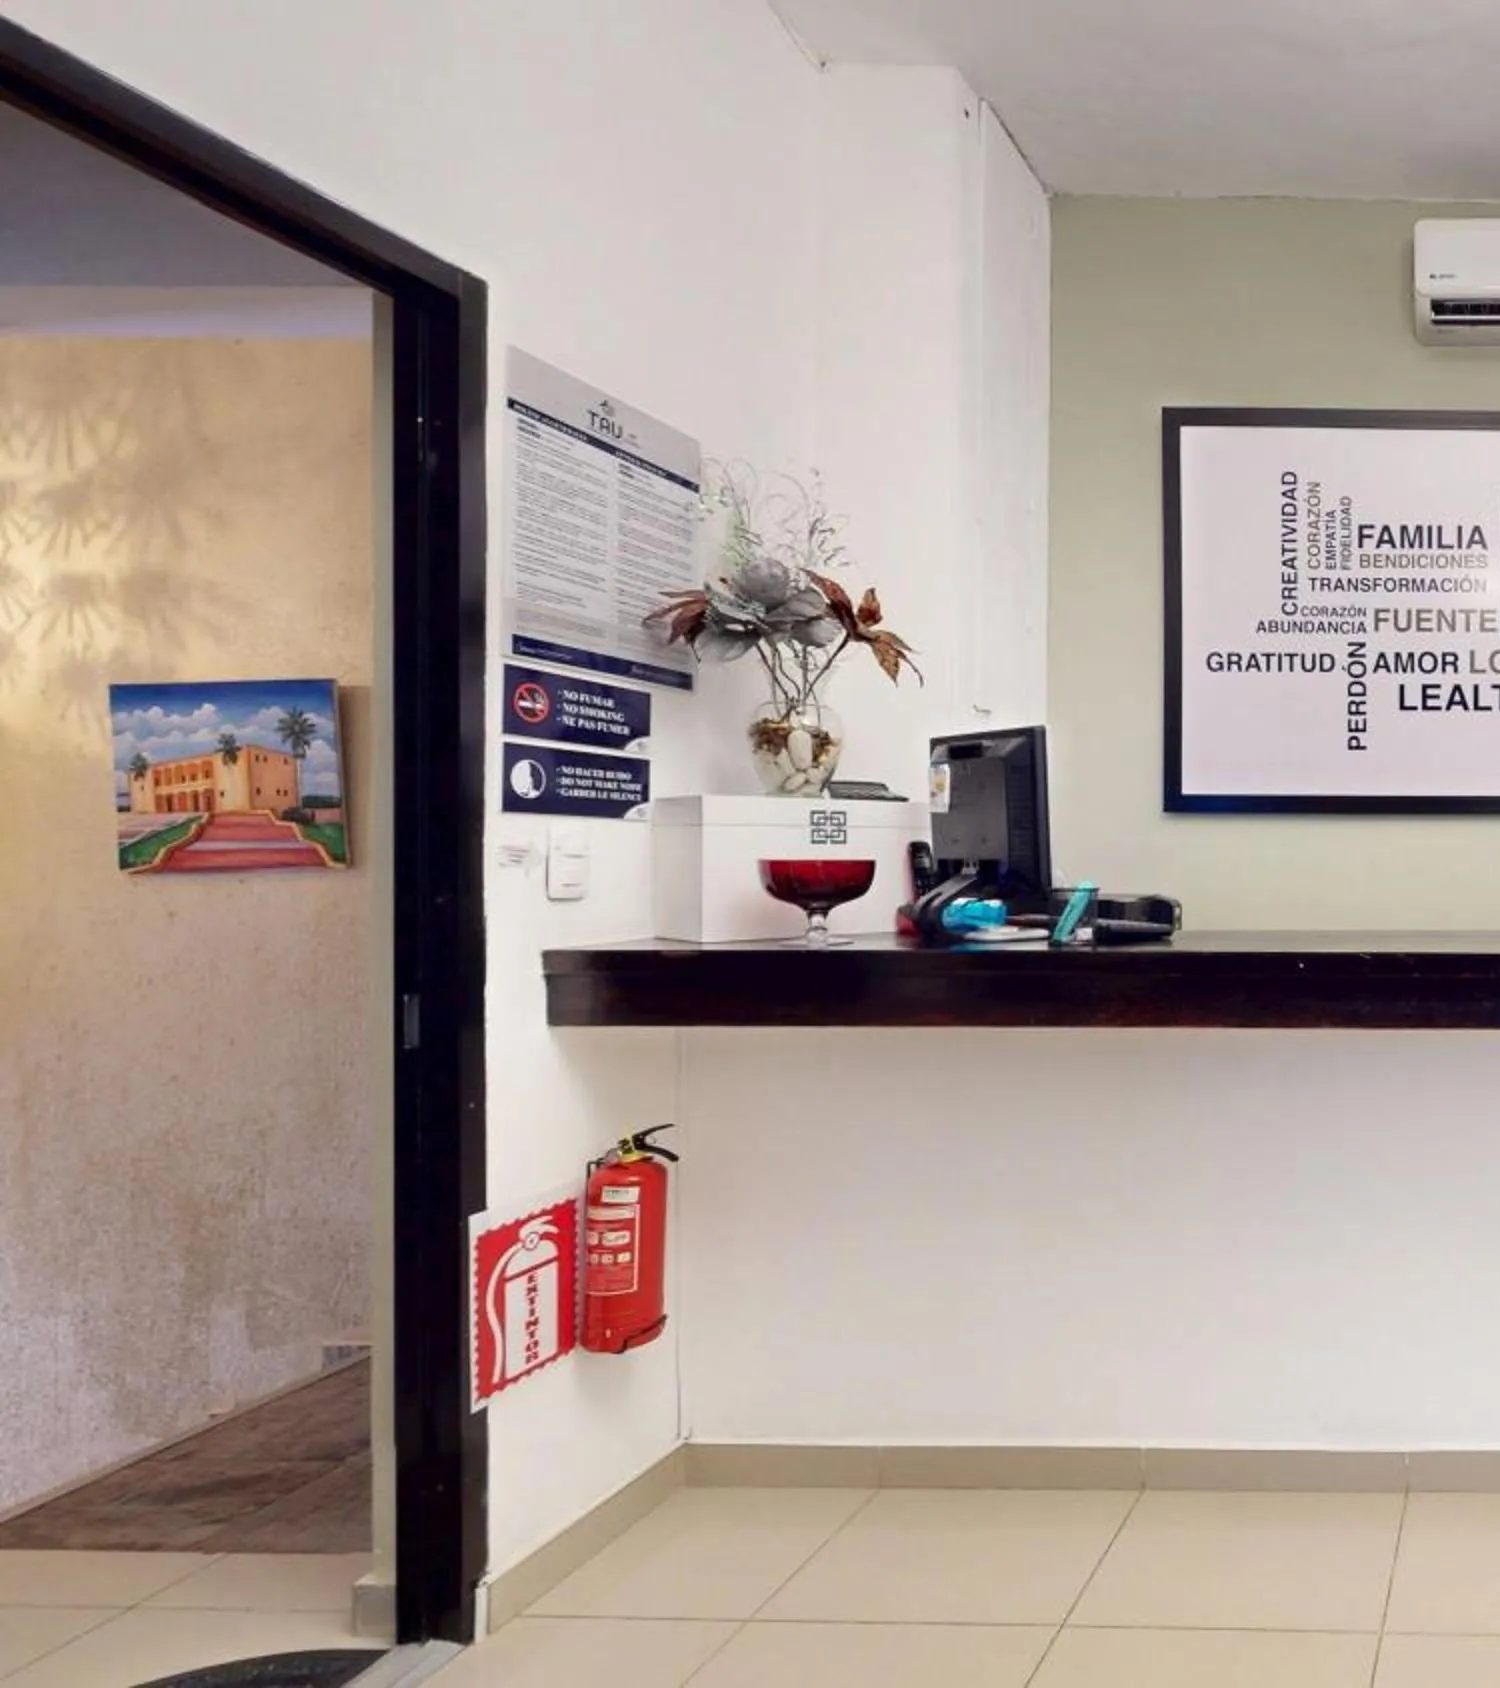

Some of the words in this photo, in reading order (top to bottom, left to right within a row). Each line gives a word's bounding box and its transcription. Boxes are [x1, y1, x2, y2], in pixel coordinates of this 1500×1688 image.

[588, 410, 623, 439] TAU
[1303, 481, 1321, 570] CORAZÓN
[1340, 496, 1353, 570] FIDELIDAD
[1357, 524, 1488, 550] FAMILIA
[1281, 471, 1298, 616] CREATIVIDAD
[1359, 553, 1488, 569] BENDICIONES
[1308, 573, 1487, 593] TRANSFORMACIÓN
[1300, 603, 1367, 618] CORAZÓN
[1373, 608, 1498, 633] FUENTE
[1256, 620, 1367, 635] ABUNDANCIA
[1206, 652, 1336, 673] GRATITUD
[1372, 651, 1460, 674] AMOR
[562, 690, 578, 701] NO
[1341, 641, 1367, 751] PERDÓN
[562, 702, 578, 714] NO
[580, 705, 625, 722] SMOKING
